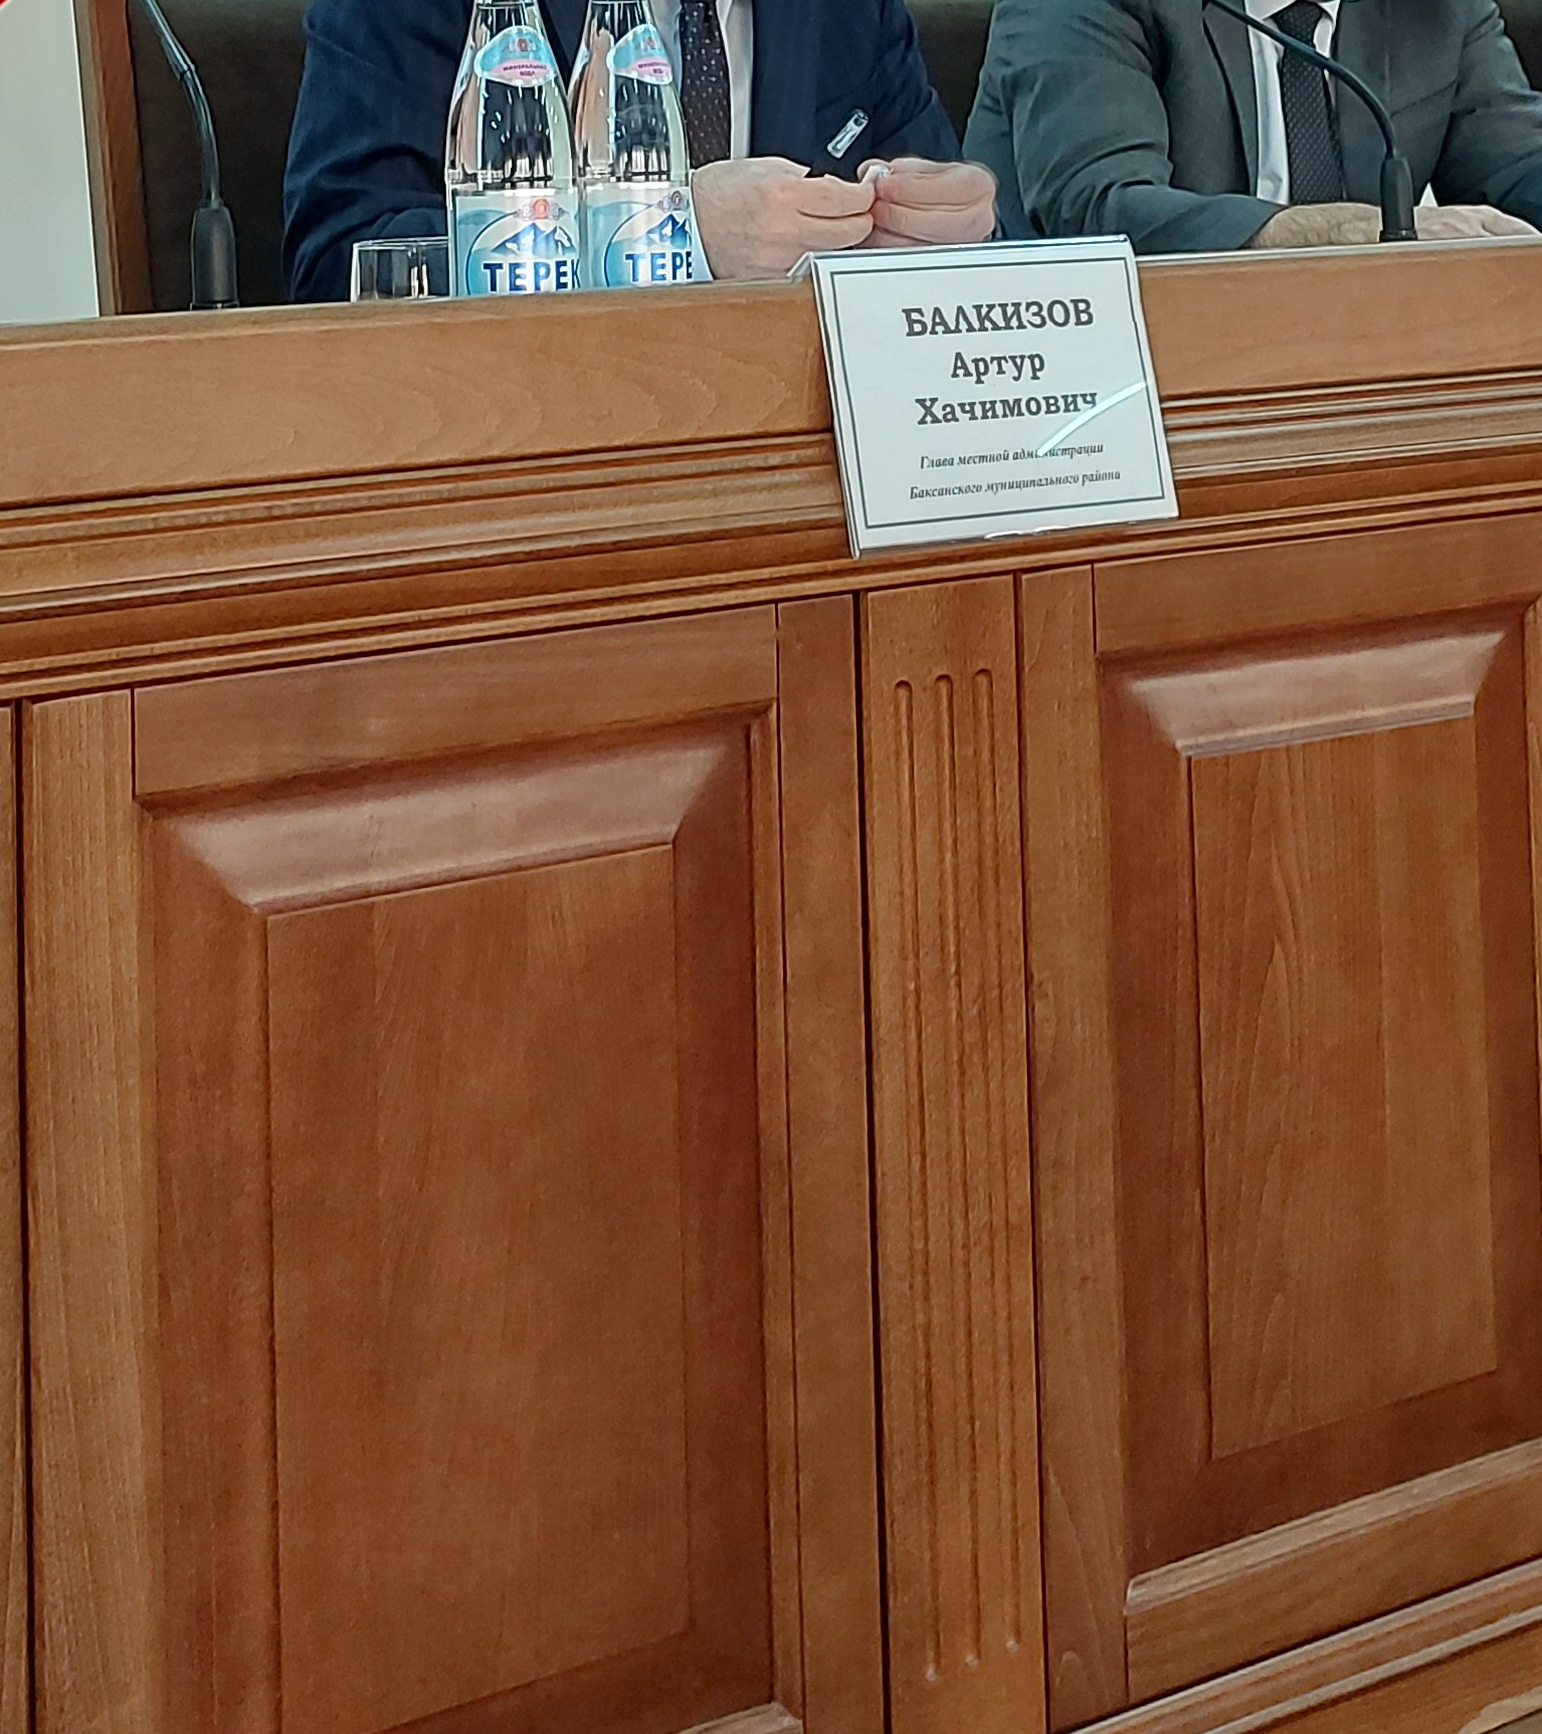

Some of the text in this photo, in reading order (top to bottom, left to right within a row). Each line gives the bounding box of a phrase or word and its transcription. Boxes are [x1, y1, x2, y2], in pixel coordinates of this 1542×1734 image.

[901, 298, 1094, 338] БАЛКИЗОВ
[950, 351, 1046, 384] Артур
[915, 392, 1098, 426] Хачимович
[920, 443, 1104, 469] Глава местной адмистрации
[909, 469, 1121, 500] Баксанского муниципального района
